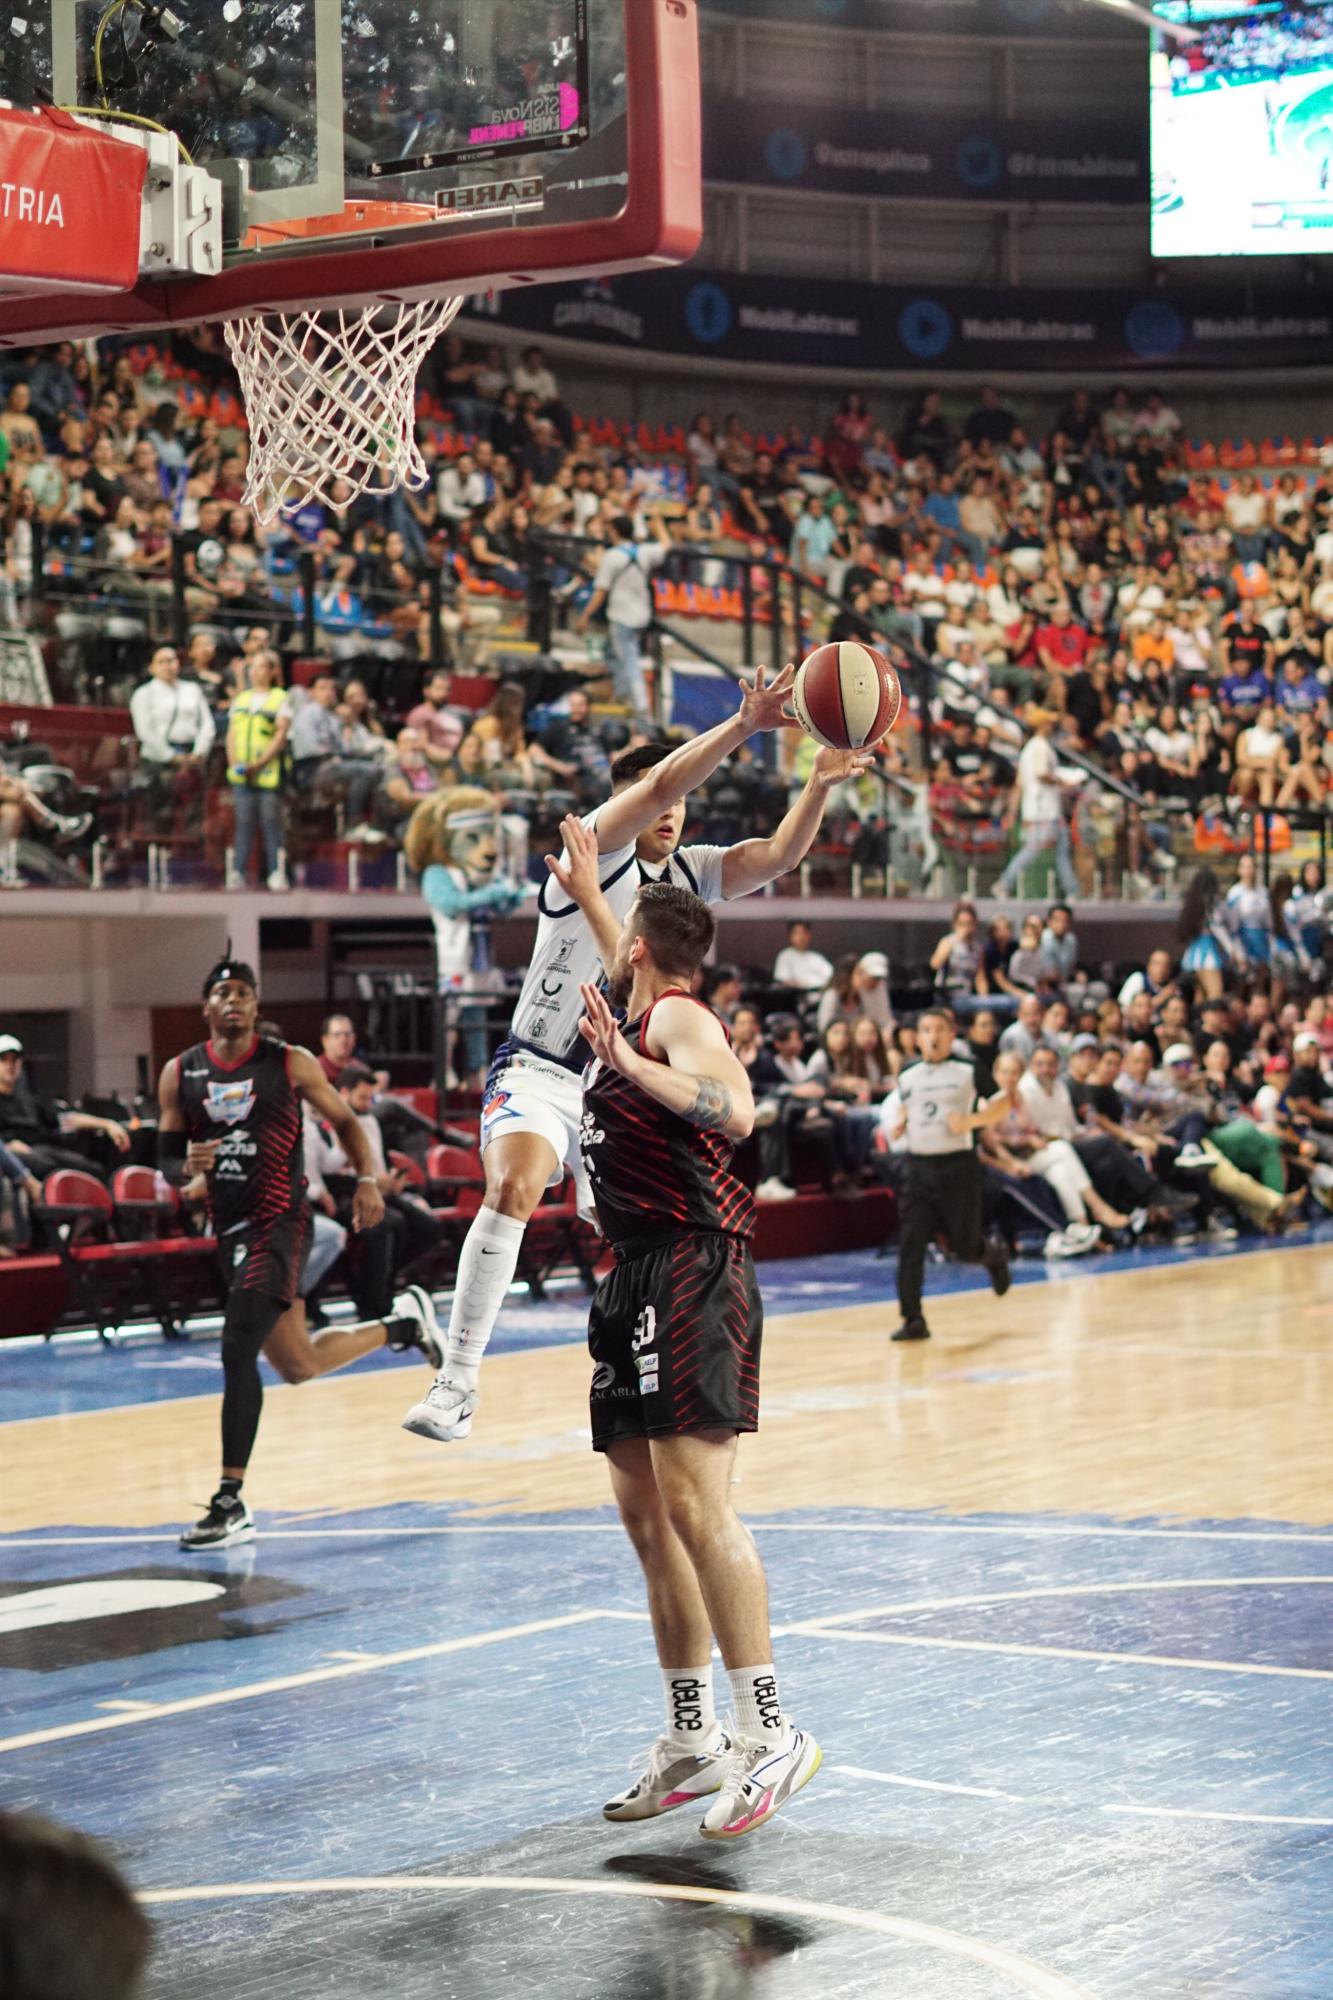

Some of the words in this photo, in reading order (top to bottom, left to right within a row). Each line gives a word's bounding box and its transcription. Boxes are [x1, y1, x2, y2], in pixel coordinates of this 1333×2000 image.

[1, 182, 64, 228] TRIA
[671, 1679, 706, 1731] deuce
[753, 1675, 781, 1729] deuce
